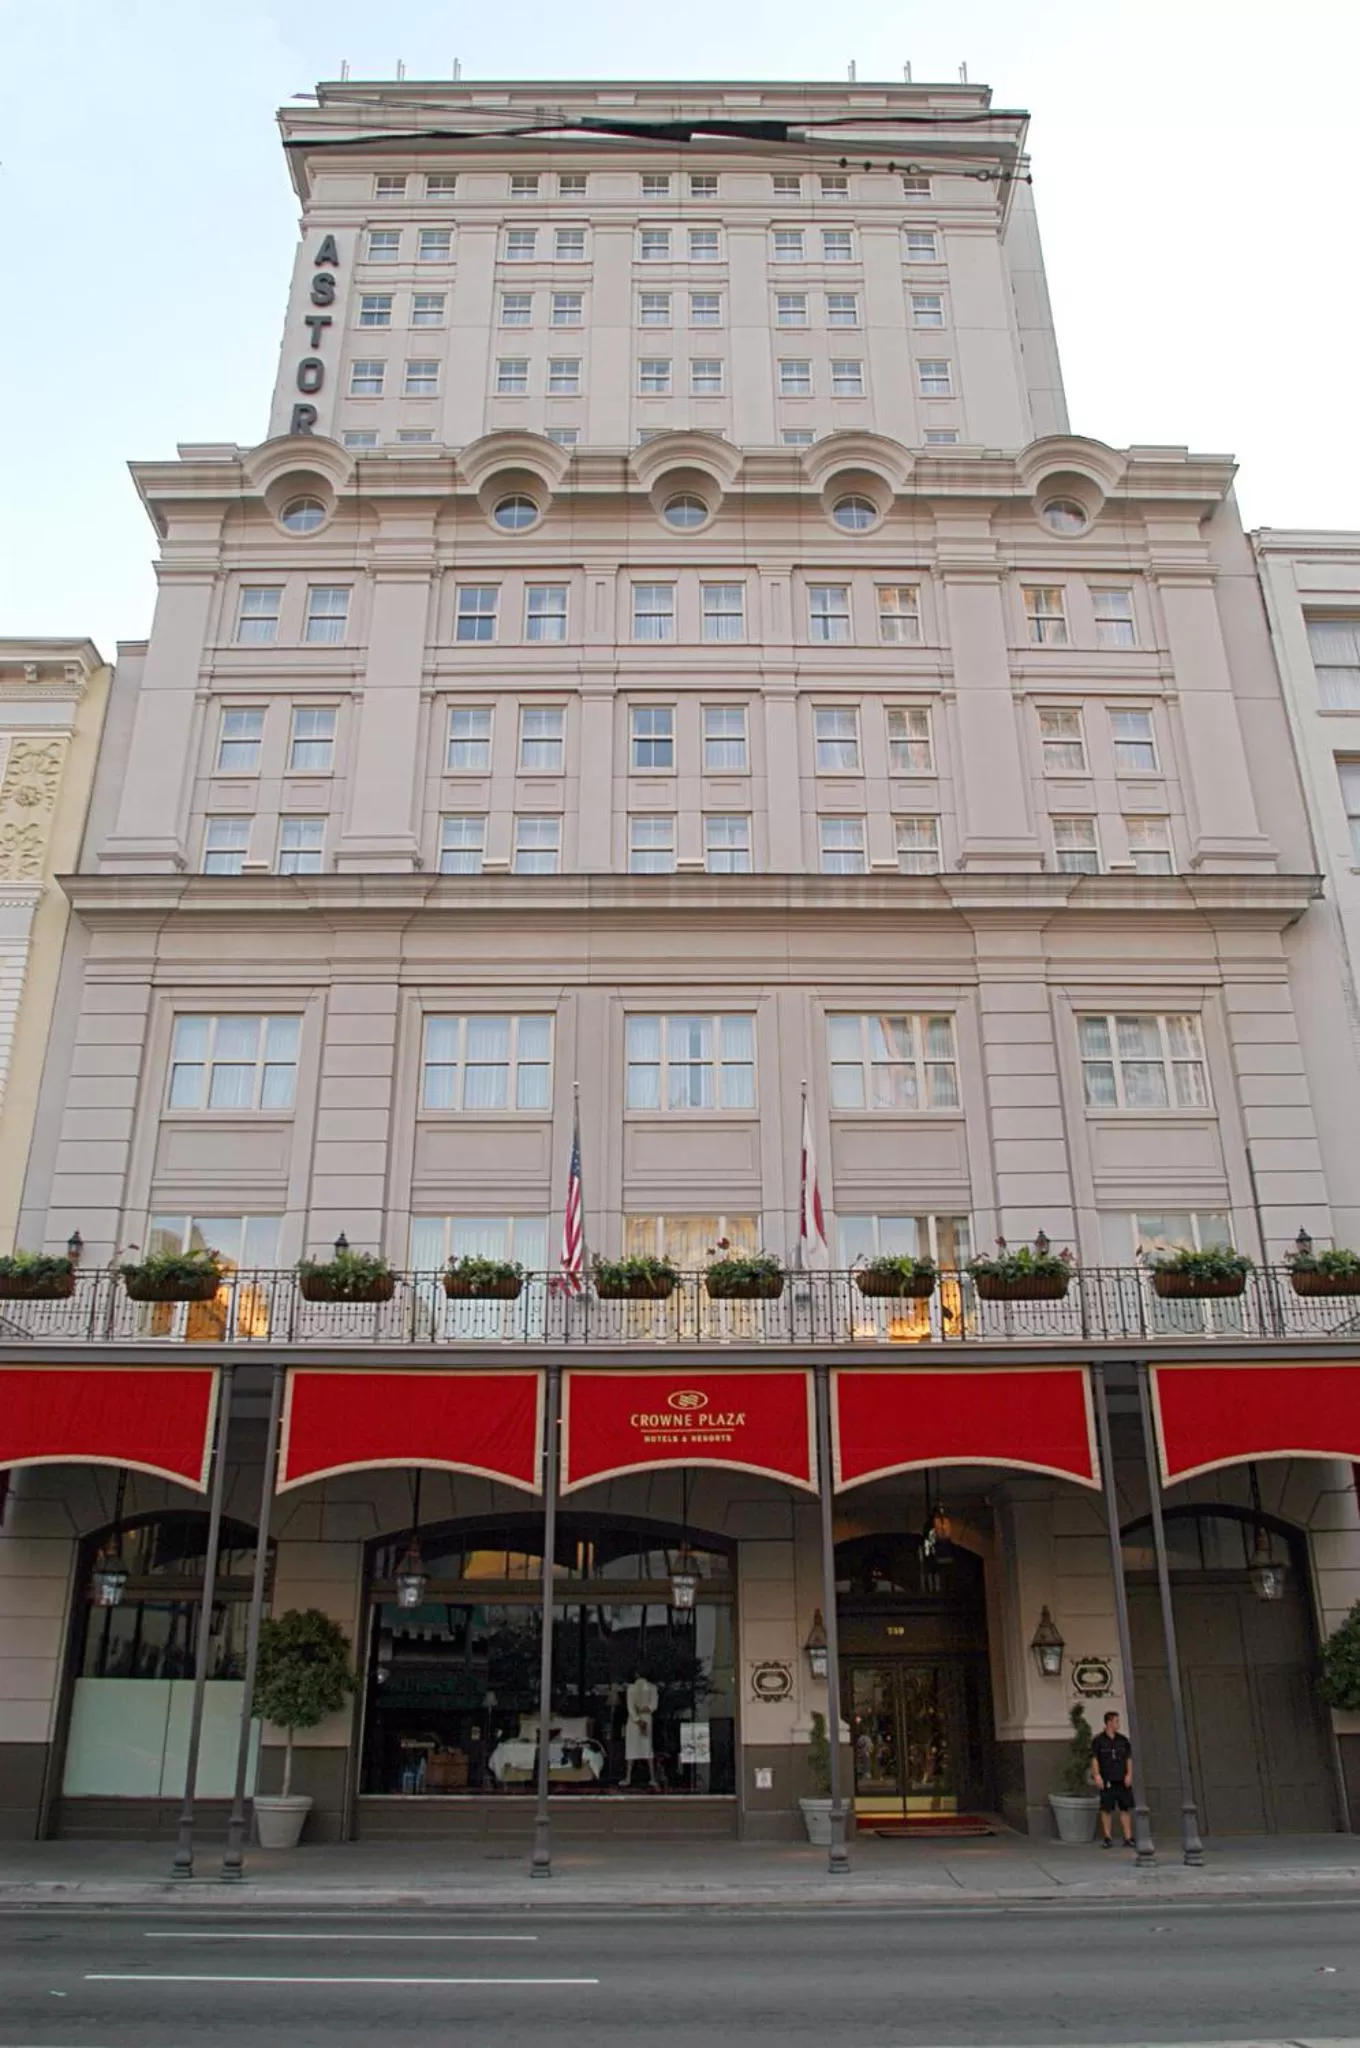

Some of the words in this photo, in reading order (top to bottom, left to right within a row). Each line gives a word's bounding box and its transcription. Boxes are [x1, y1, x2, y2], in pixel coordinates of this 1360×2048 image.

[290, 234, 339, 435] ASTOR
[630, 1413, 693, 1427] CROWNE
[699, 1412, 746, 1426] PLAZA
[691, 1434, 732, 1442] RESORTS
